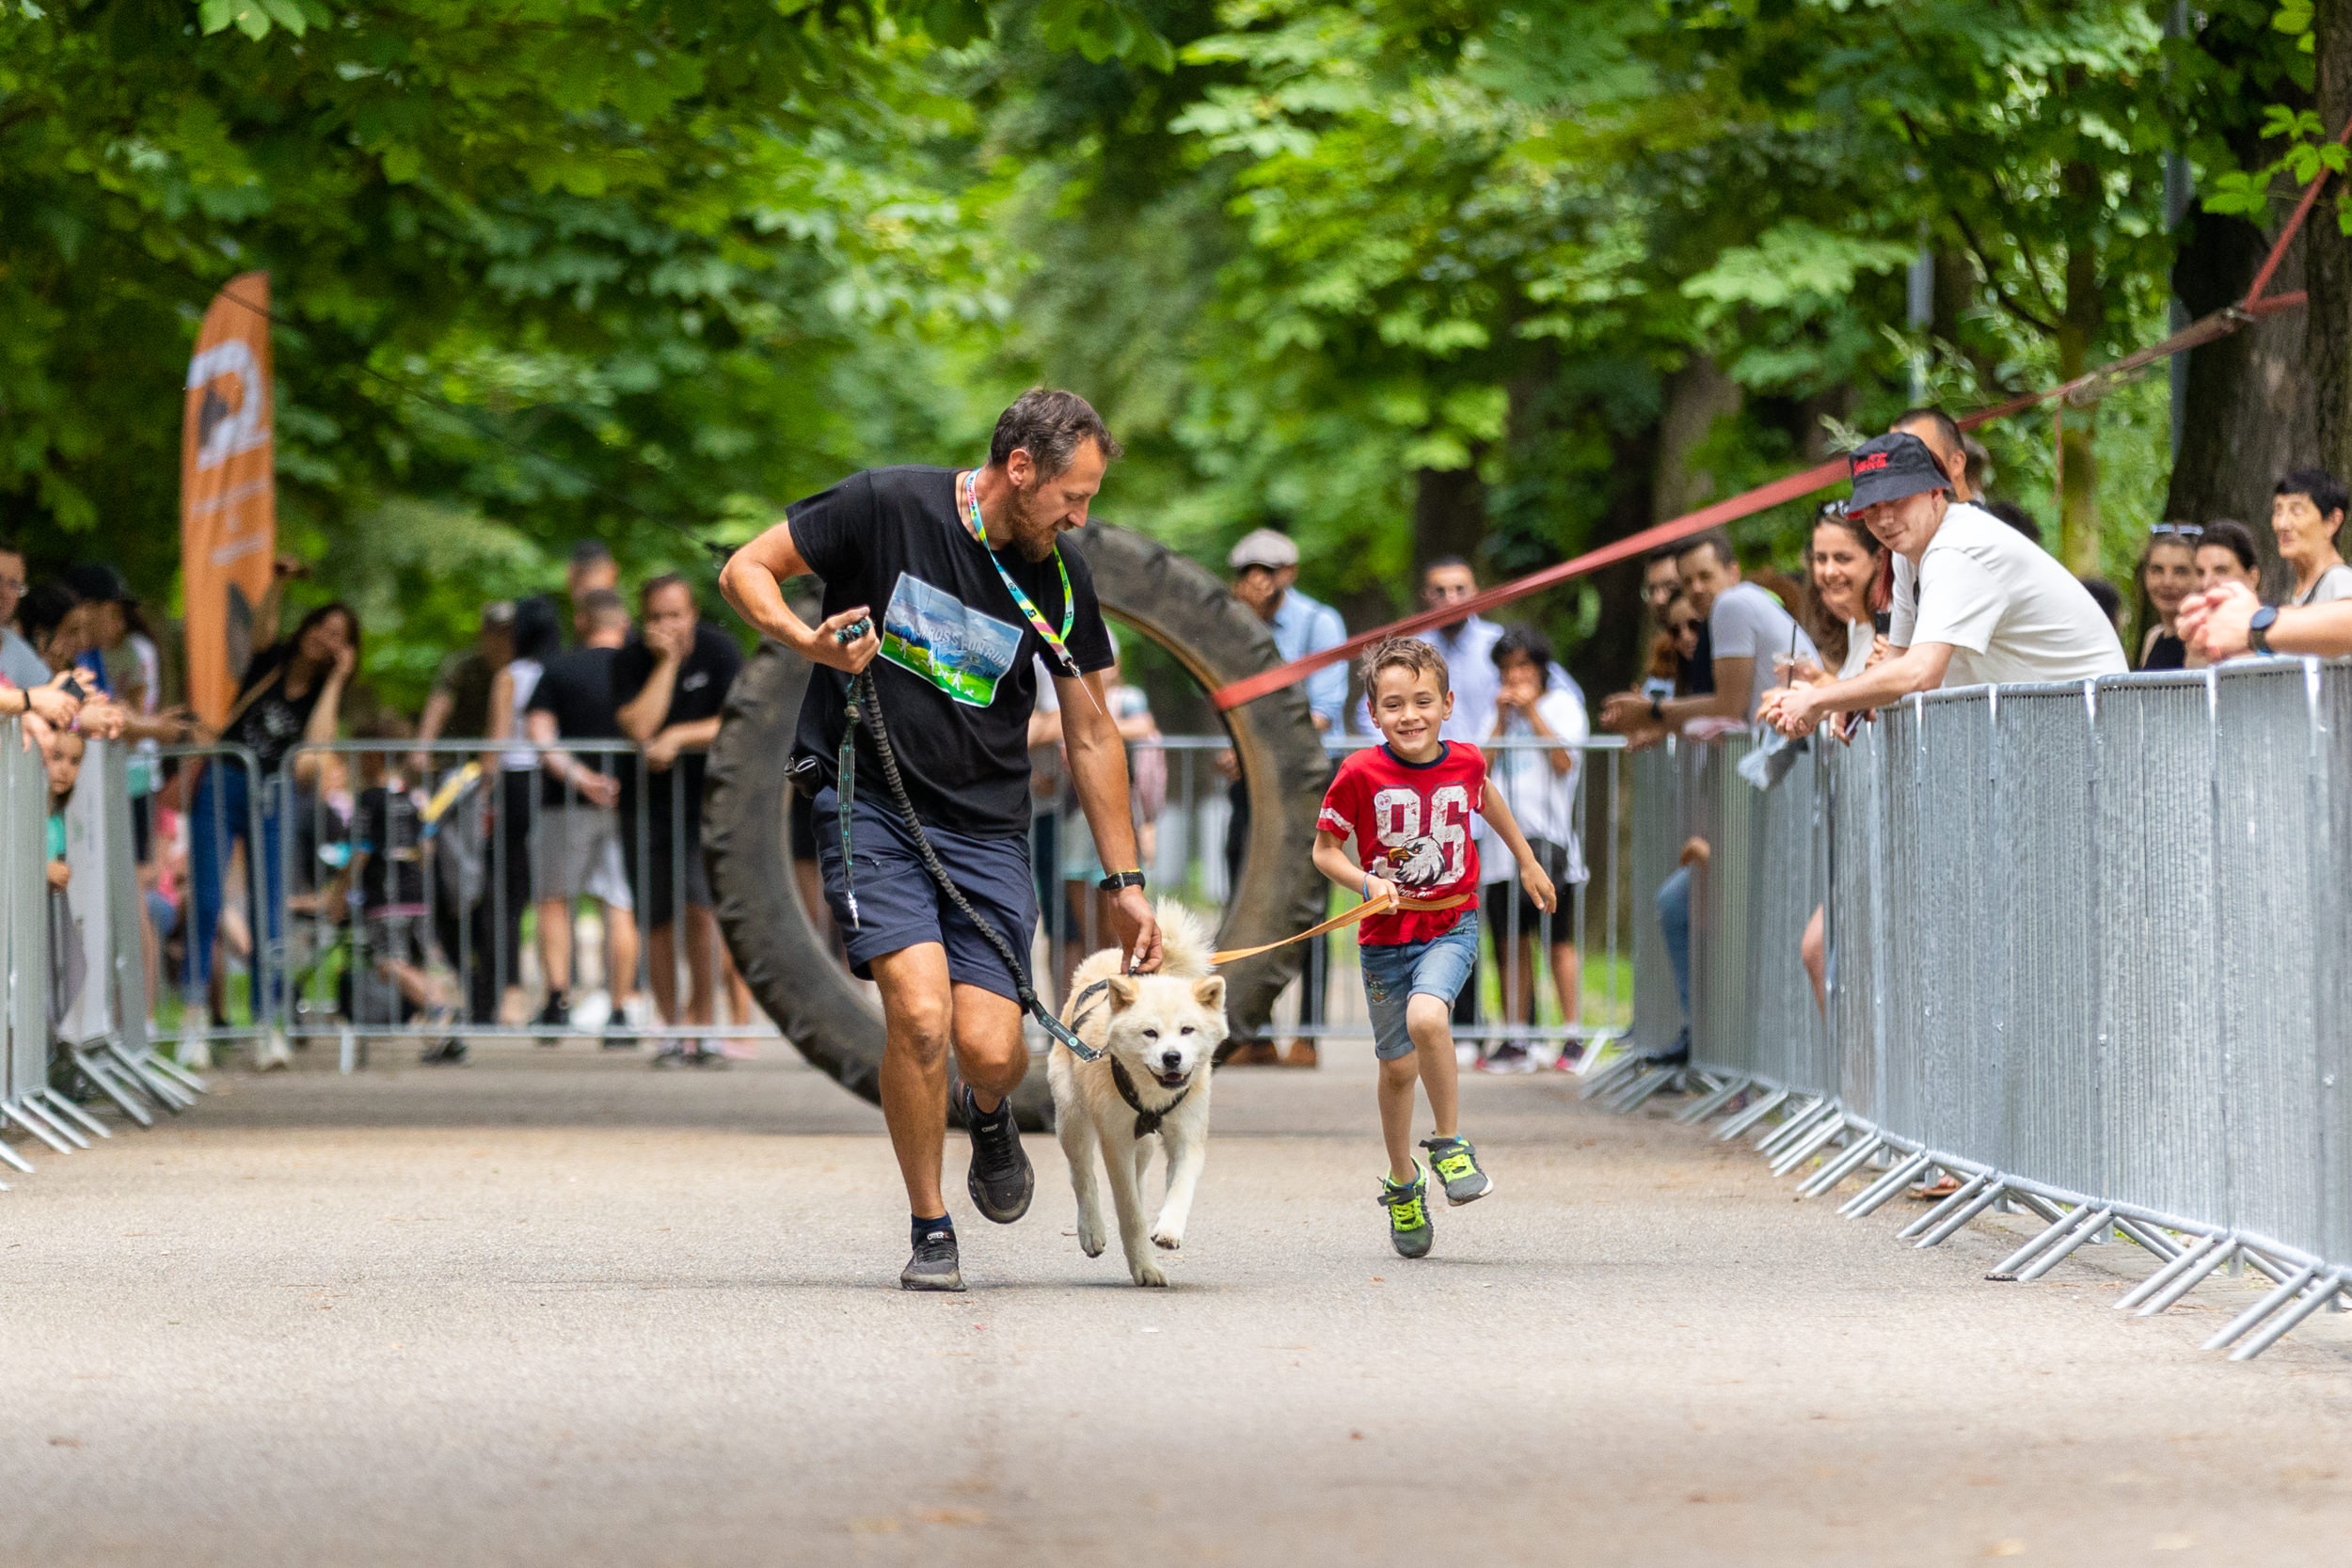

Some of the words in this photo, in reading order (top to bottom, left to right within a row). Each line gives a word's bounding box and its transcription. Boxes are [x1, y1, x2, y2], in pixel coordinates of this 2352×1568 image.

[961, 637, 986, 654] FUN
[985, 645, 1009, 667] RUN
[1373, 783, 1469, 884] 96
